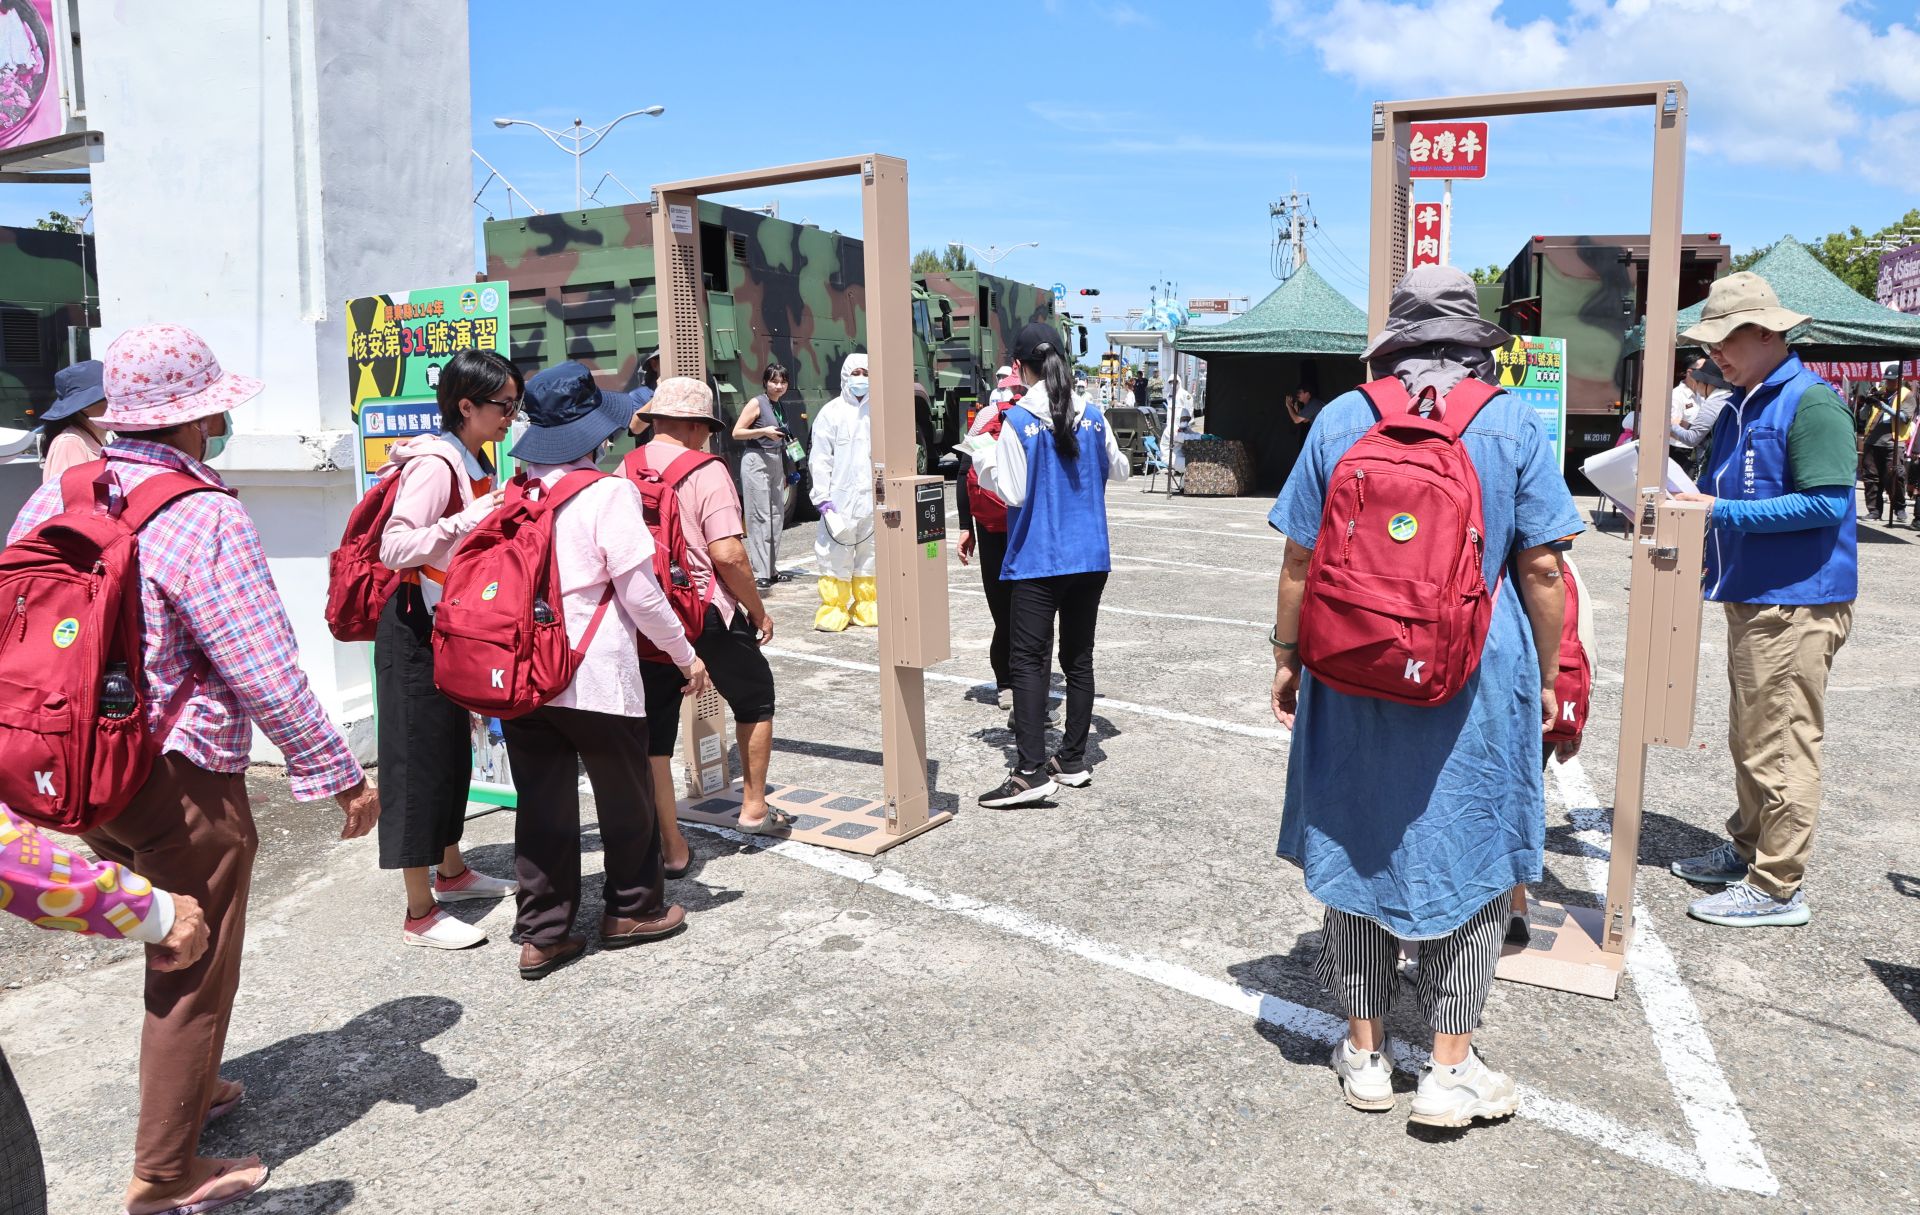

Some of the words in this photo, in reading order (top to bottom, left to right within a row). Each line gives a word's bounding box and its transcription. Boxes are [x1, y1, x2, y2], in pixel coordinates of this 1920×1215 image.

[353, 318, 498, 360] 核安第31號演習
[491, 668, 505, 689] K
[1404, 658, 1425, 683] K
[1563, 701, 1576, 721] K
[34, 770, 57, 796] K
